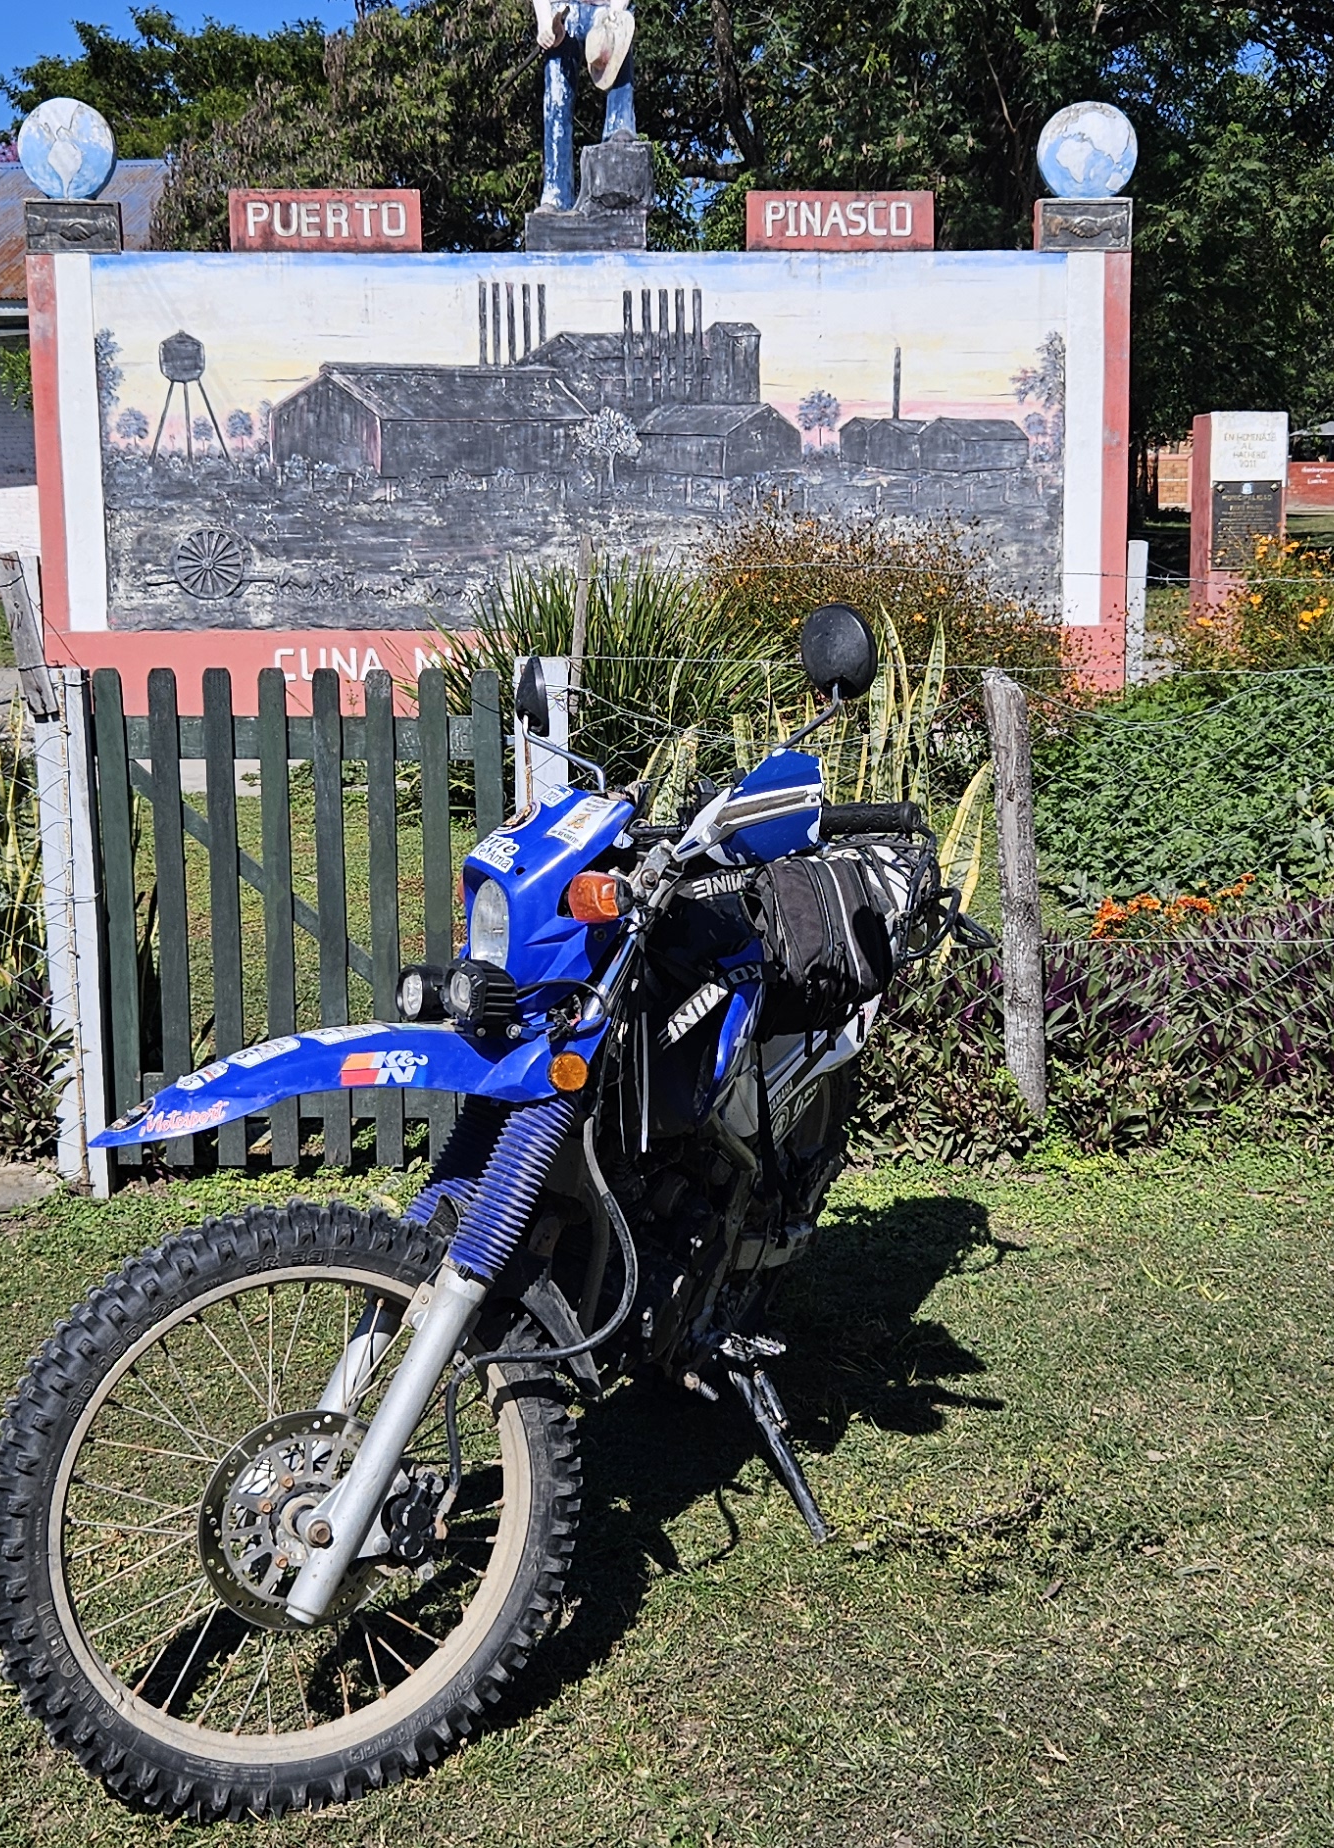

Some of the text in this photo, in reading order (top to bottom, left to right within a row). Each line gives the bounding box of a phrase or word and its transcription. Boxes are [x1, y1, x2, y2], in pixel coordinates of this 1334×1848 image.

[246, 200, 407, 238] PUERTO
[764, 199, 914, 238] PINASCO
[36, 1600, 118, 1730] RINALDI
